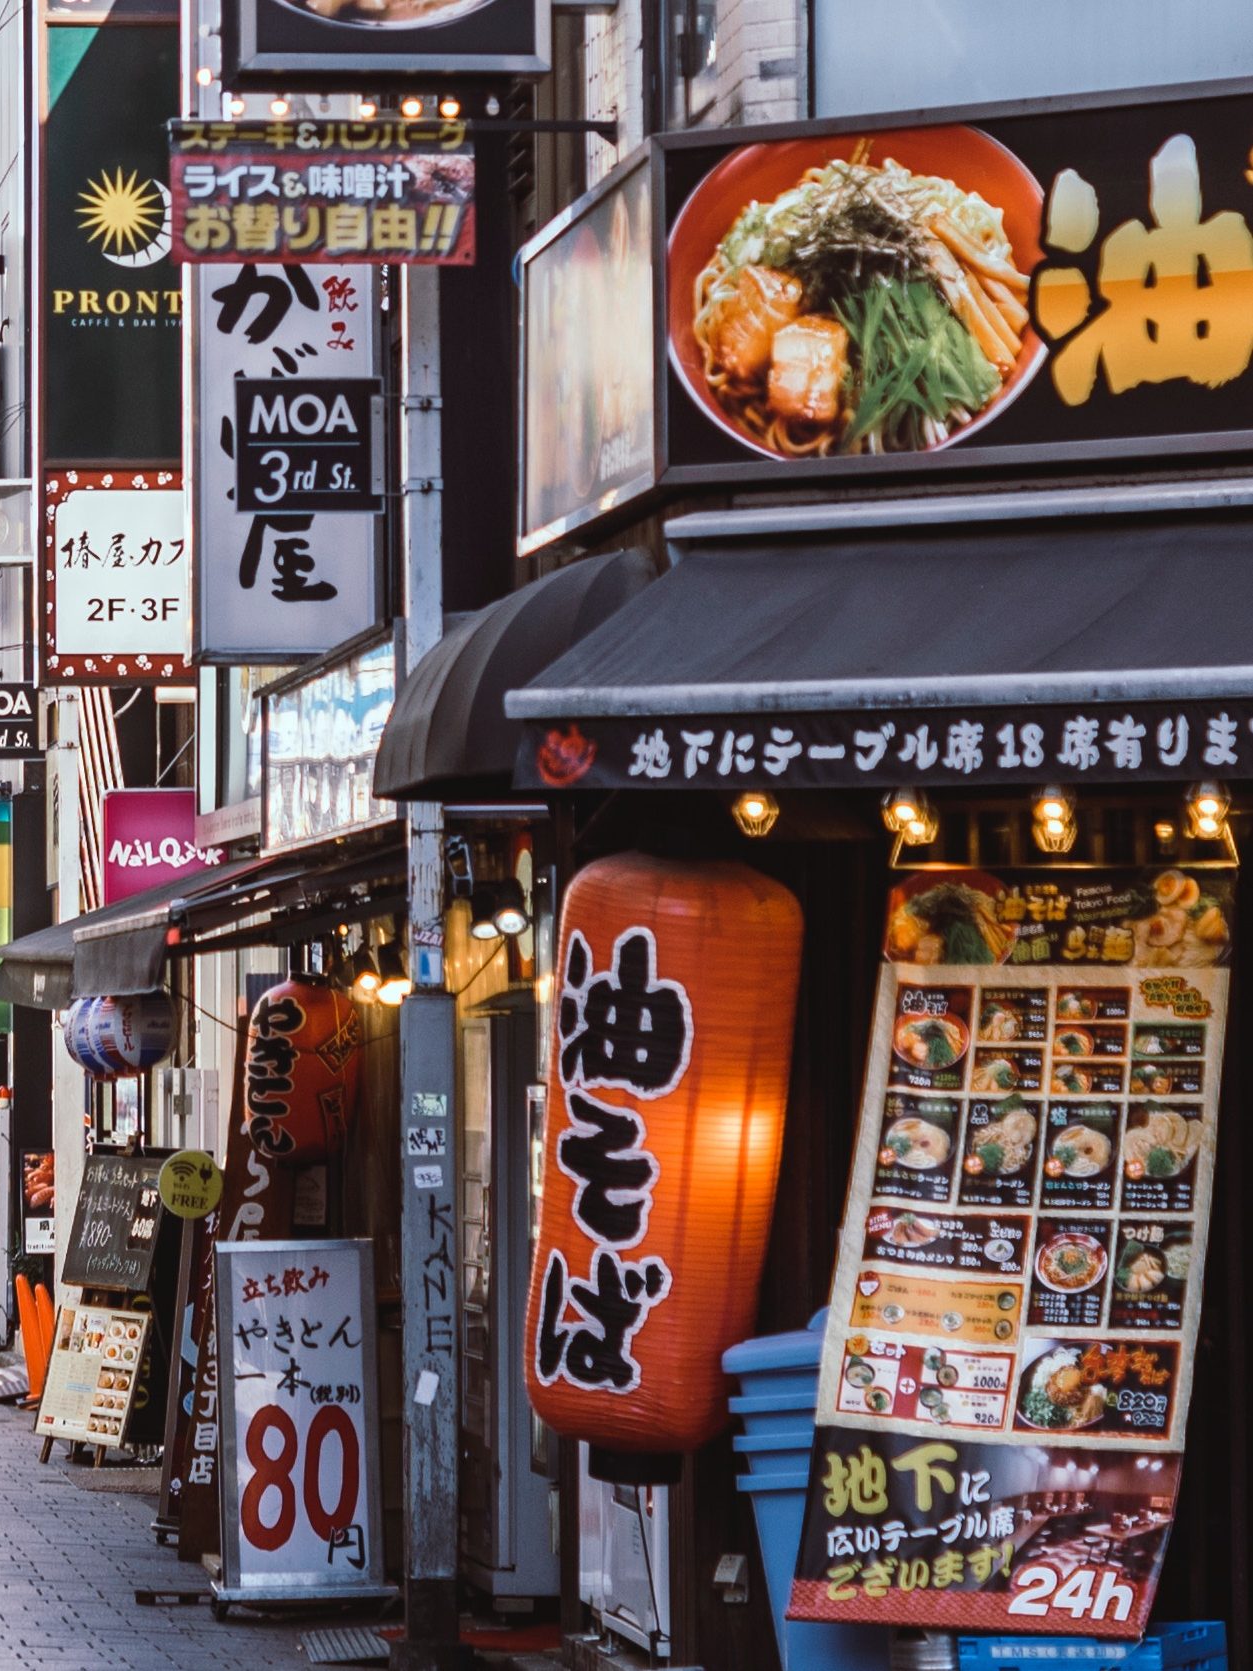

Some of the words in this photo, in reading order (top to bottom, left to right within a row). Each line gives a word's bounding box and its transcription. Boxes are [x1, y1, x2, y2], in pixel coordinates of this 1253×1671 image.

[182, 164, 411, 200] ライス&味噌汁
[185, 203, 460, 251] お替り自由!!
[1036, 132, 1253, 407] 油
[118, 318, 125, 328] &
[248, 394, 358, 435] MOA
[254, 450, 315, 503] 3rd
[328, 462, 357, 492] St.
[14, 730, 32, 749] St.
[1075, 898, 1103, 911] Tokyo
[1106, 894, 1132, 906] Food
[537, 924, 692, 1393] 油そば
[171, 1193, 209, 1210] FREE
[241, 1265, 330, 1304] 立ち飲み
[234, 1314, 363, 1354] やきとん
[234, 1357, 311, 1399] 一本
[241, 1403, 360, 1552] 80
[823, 1442, 992, 1518] 地下に
[327, 1524, 366, 1570] 円
[826, 1506, 1015, 1558] 広いテーブル席
[825, 1542, 1014, 1602] ございます!
[1007, 1565, 1135, 1622] 24h
